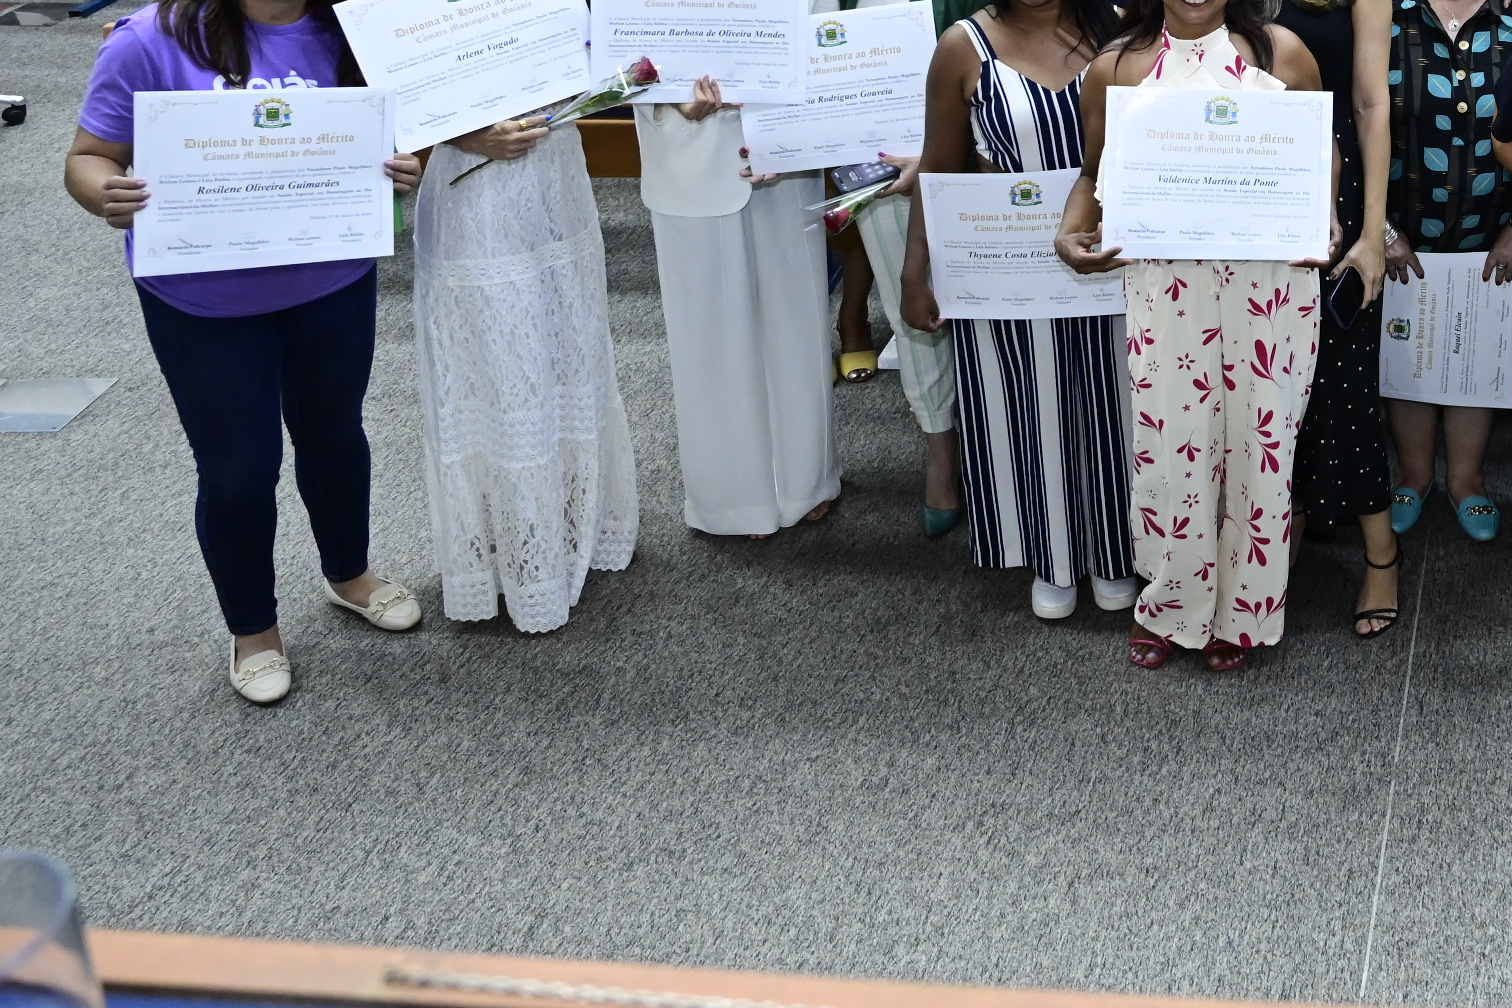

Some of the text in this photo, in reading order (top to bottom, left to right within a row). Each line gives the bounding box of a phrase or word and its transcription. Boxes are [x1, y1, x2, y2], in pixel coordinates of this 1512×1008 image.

[614, 28, 666, 37] Francimara
[669, 28, 705, 37] Barbosa
[718, 29, 752, 38] Oliveira
[753, 30, 786, 40] Mendes
[197, 178, 340, 195] Rosilene Oliveira Guimarães
[1004, 250, 1028, 259] Costa
